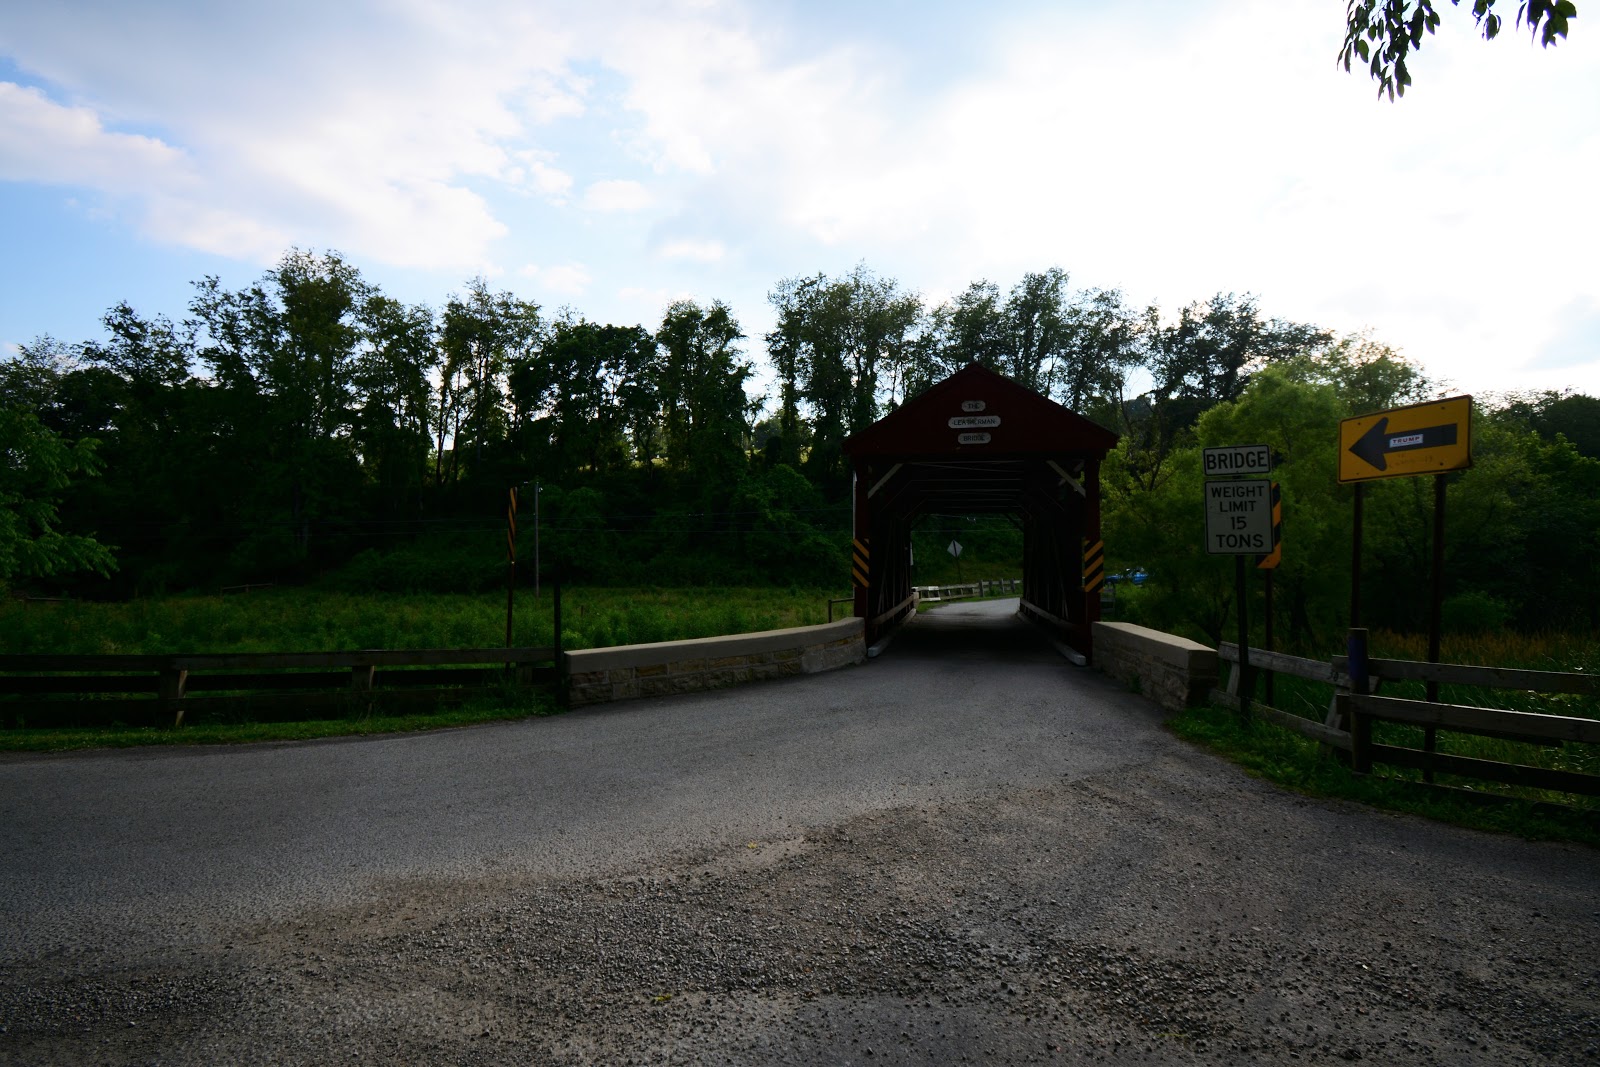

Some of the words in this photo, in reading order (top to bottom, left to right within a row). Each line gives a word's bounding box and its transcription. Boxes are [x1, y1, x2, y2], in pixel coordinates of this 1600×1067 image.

[1392, 436, 1420, 444] TRUMP
[1206, 451, 1267, 470] BRIDGE
[1211, 486, 1265, 498] WEIGHT
[1219, 500, 1256, 512] LIMIT
[1230, 516, 1247, 530] 15
[1215, 534, 1264, 548] TONS
